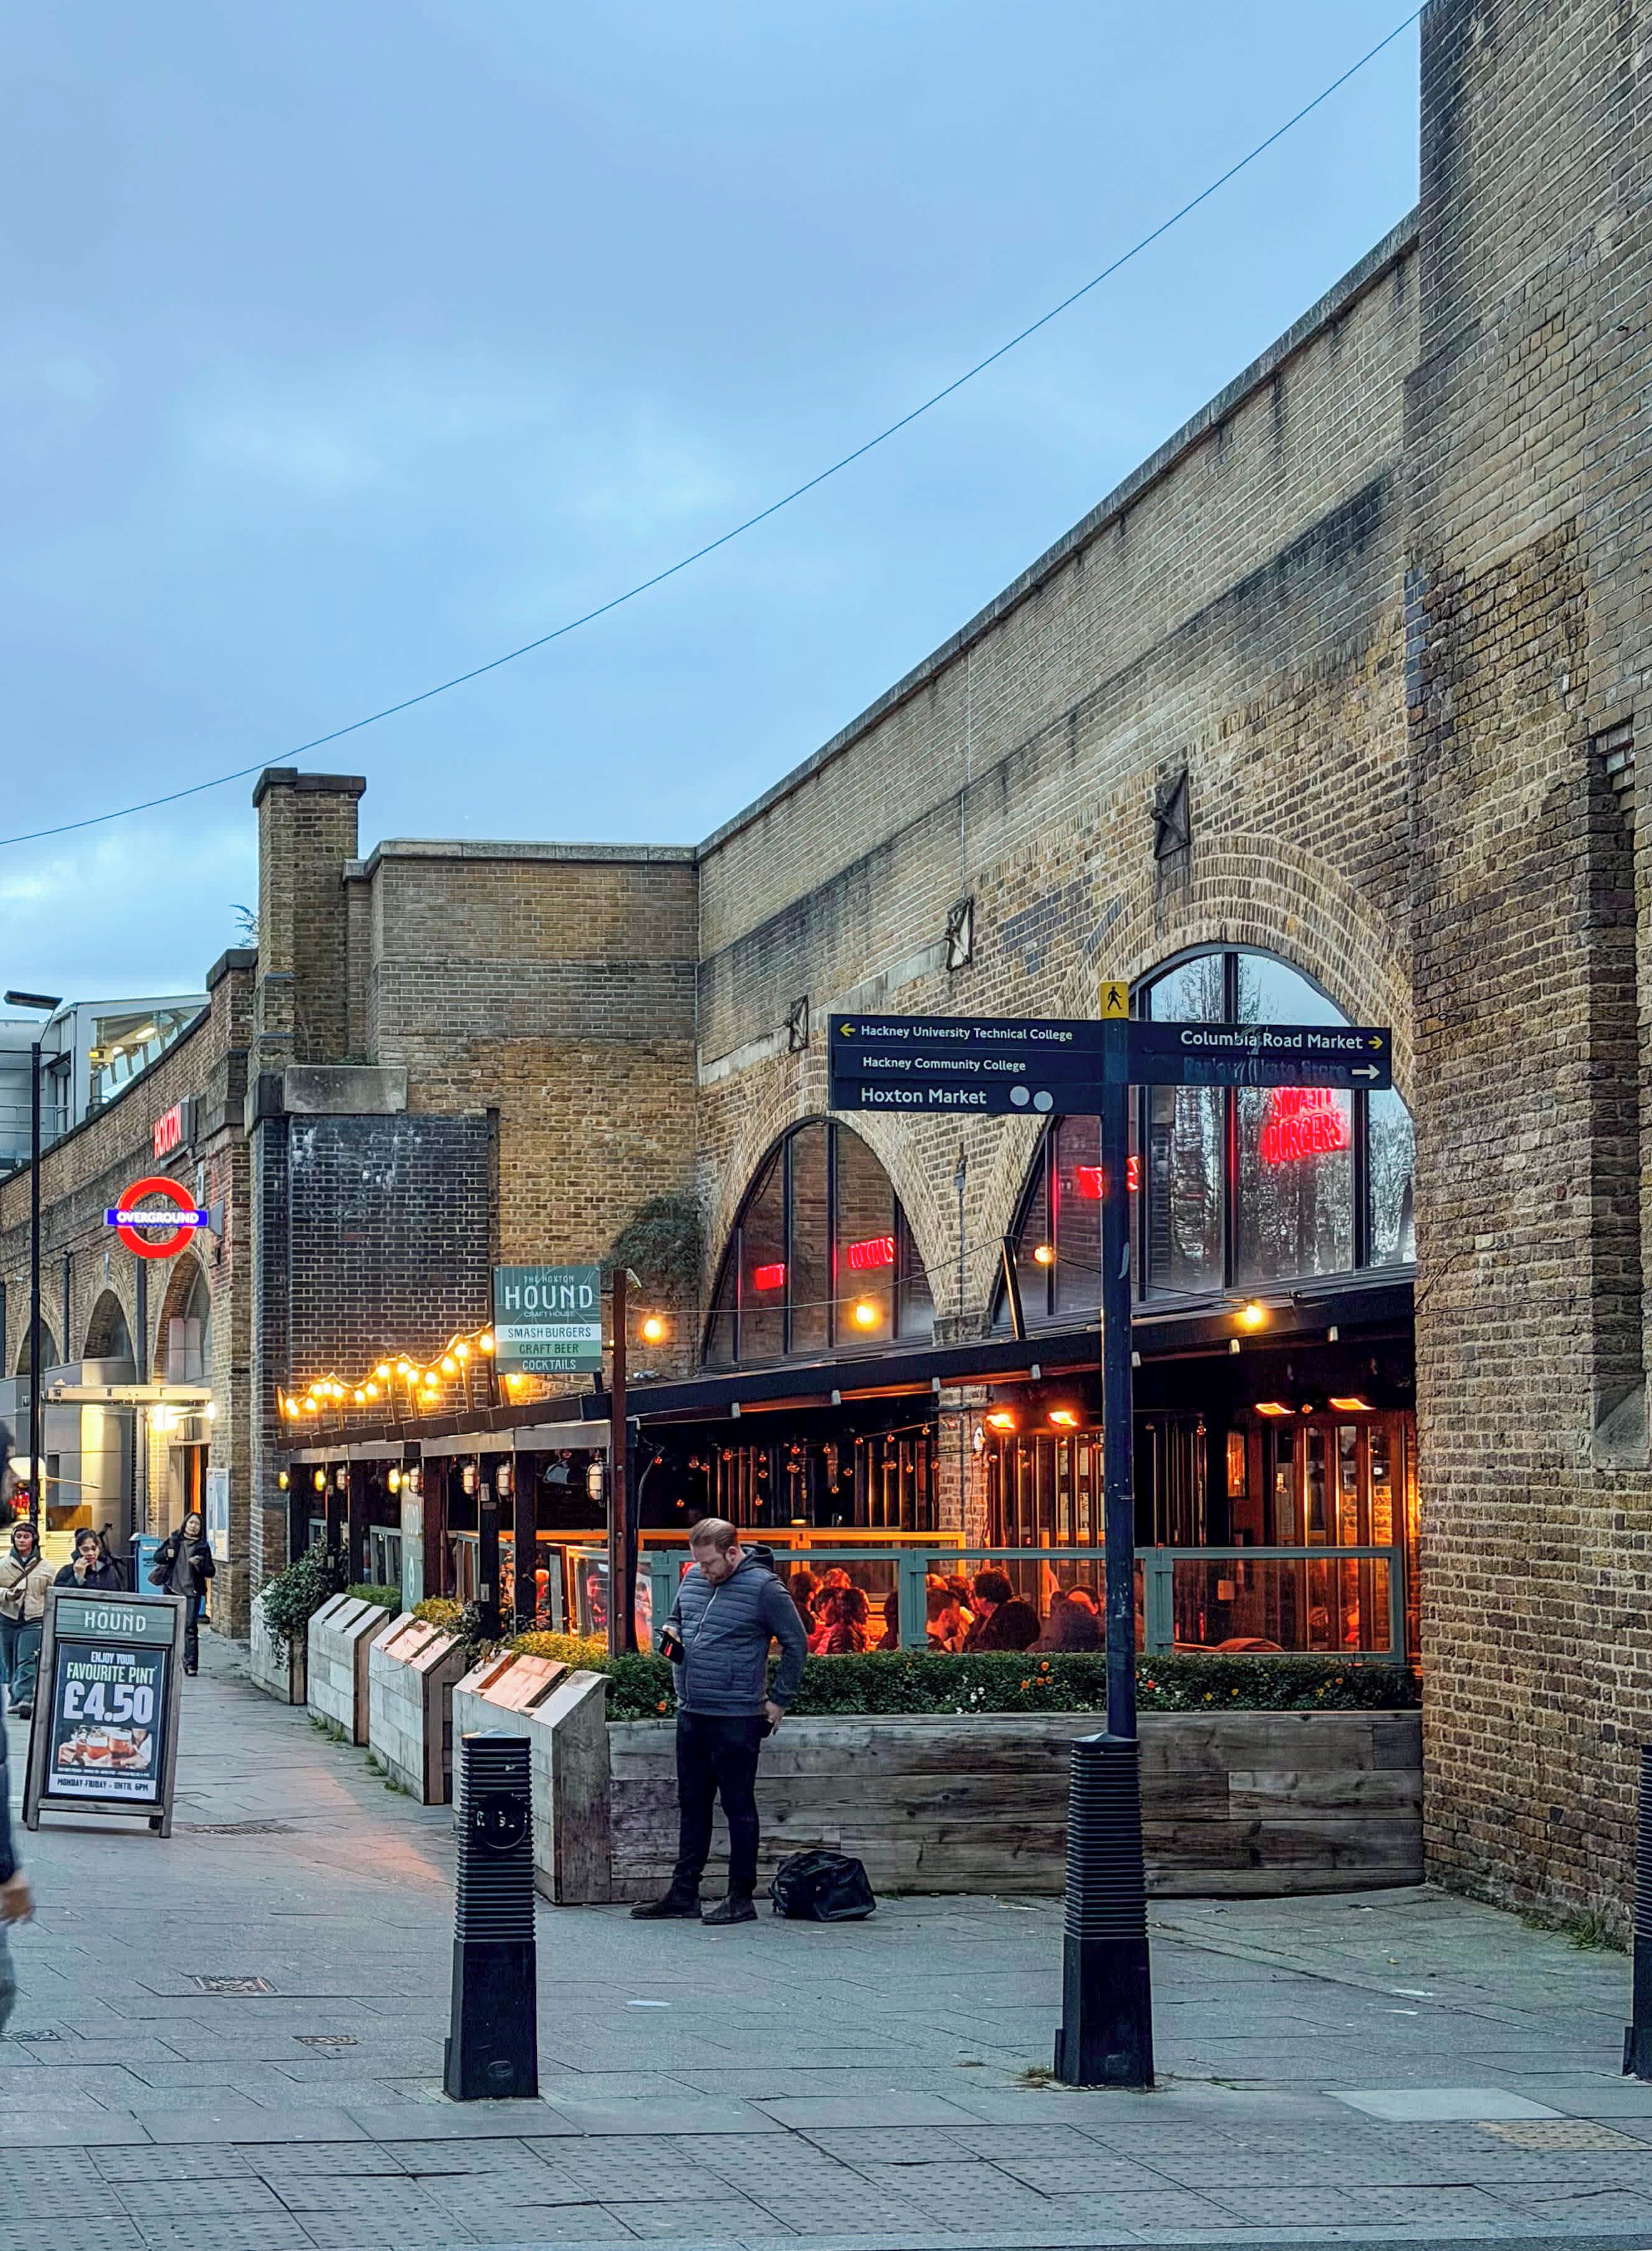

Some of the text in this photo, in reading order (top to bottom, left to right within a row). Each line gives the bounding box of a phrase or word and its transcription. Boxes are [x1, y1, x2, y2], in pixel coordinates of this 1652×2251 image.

[861, 1024, 1073, 1042] Hackney University Technical College
[1181, 1030, 1363, 1049] Columbia Road Market
[863, 1057, 1026, 1073] Hackney Community College
[861, 1087, 987, 1105] Hoxton Market
[1267, 1109, 1345, 1162] BURGERS
[116, 1211, 200, 1224] OVERGROUND
[524, 1275, 575, 1283] THE HOXTON
[504, 1285, 593, 1310] HOUND
[508, 1327, 592, 1338] SMASH BURGERS
[519, 1343, 579, 1354] CRAFT BEER
[522, 1359, 577, 1370] COCKTAILS
[84, 1611, 146, 1633] HOUND
[91, 1651, 136, 1666] ENJOY YOUR
[66, 1661, 126, 1682] FAVOURITE
[63, 1681, 154, 1724] £4.50
[134, 1783, 149, 1792] 6PM
